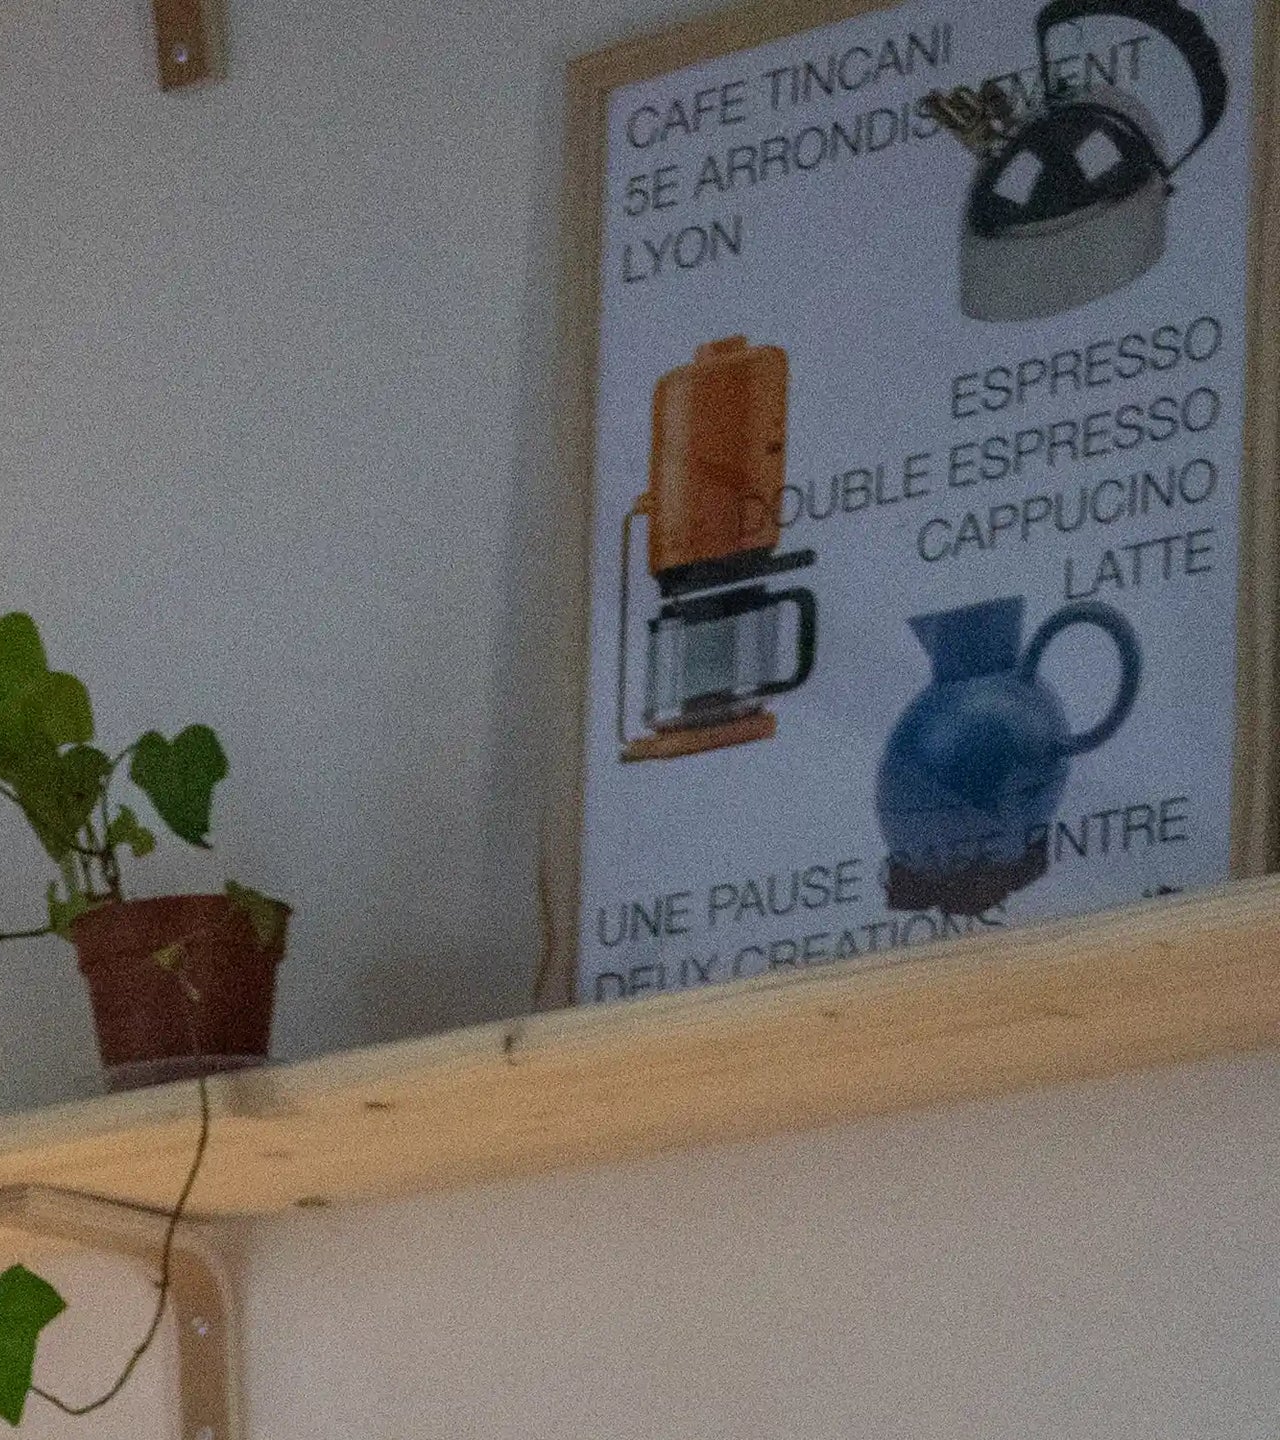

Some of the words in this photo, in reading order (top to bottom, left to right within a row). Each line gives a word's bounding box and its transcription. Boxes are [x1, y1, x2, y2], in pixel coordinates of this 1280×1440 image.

[626, 80, 745, 150] CAFE
[761, 22, 954, 112] TINCANI
[624, 165, 679, 217] 5E
[621, 214, 743, 284] LYON
[951, 315, 1223, 420] ESPRESSO
[947, 386, 1221, 488] ESPRESSO
[915, 457, 1219, 563] CAPPUCINO
[1064, 527, 1217, 600] LATTE
[596, 890, 691, 948] UNE
[707, 858, 864, 927] PAUSE
